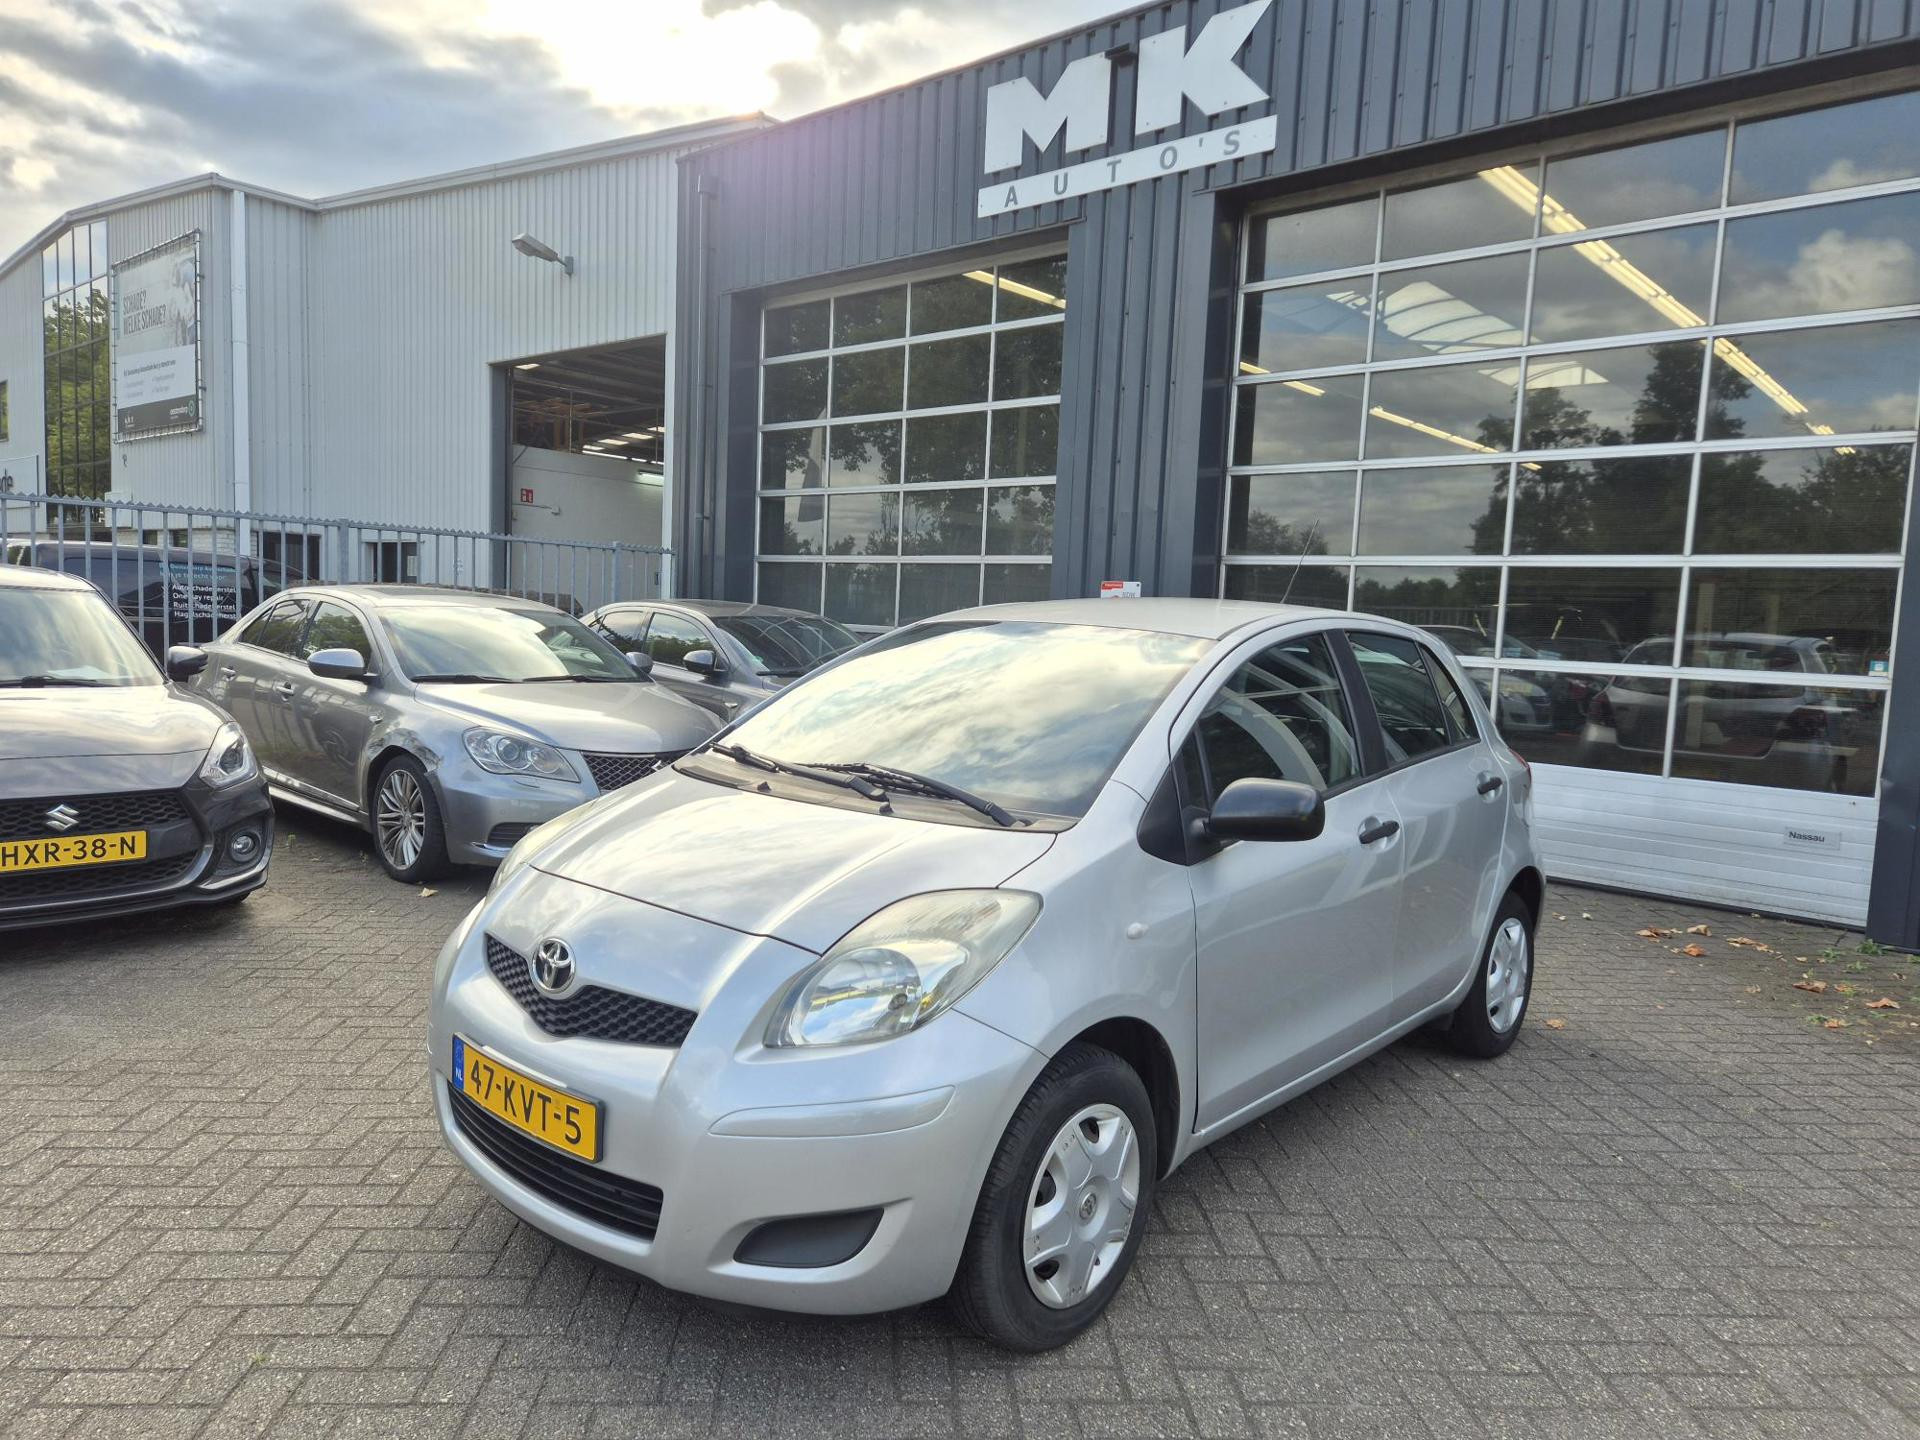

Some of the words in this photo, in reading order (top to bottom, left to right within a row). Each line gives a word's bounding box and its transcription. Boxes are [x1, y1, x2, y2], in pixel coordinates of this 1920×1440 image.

[985, 0, 1273, 174] MK
[1004, 130, 1240, 208] AUTO'S
[172, 584, 236, 593] Autochadeerstel
[173, 601, 236, 610] Ruitchadeerstel
[1, 835, 136, 867] HXR-38-N
[1788, 831, 1825, 843] Nassau
[470, 1059, 582, 1145] 47-KVT-5
